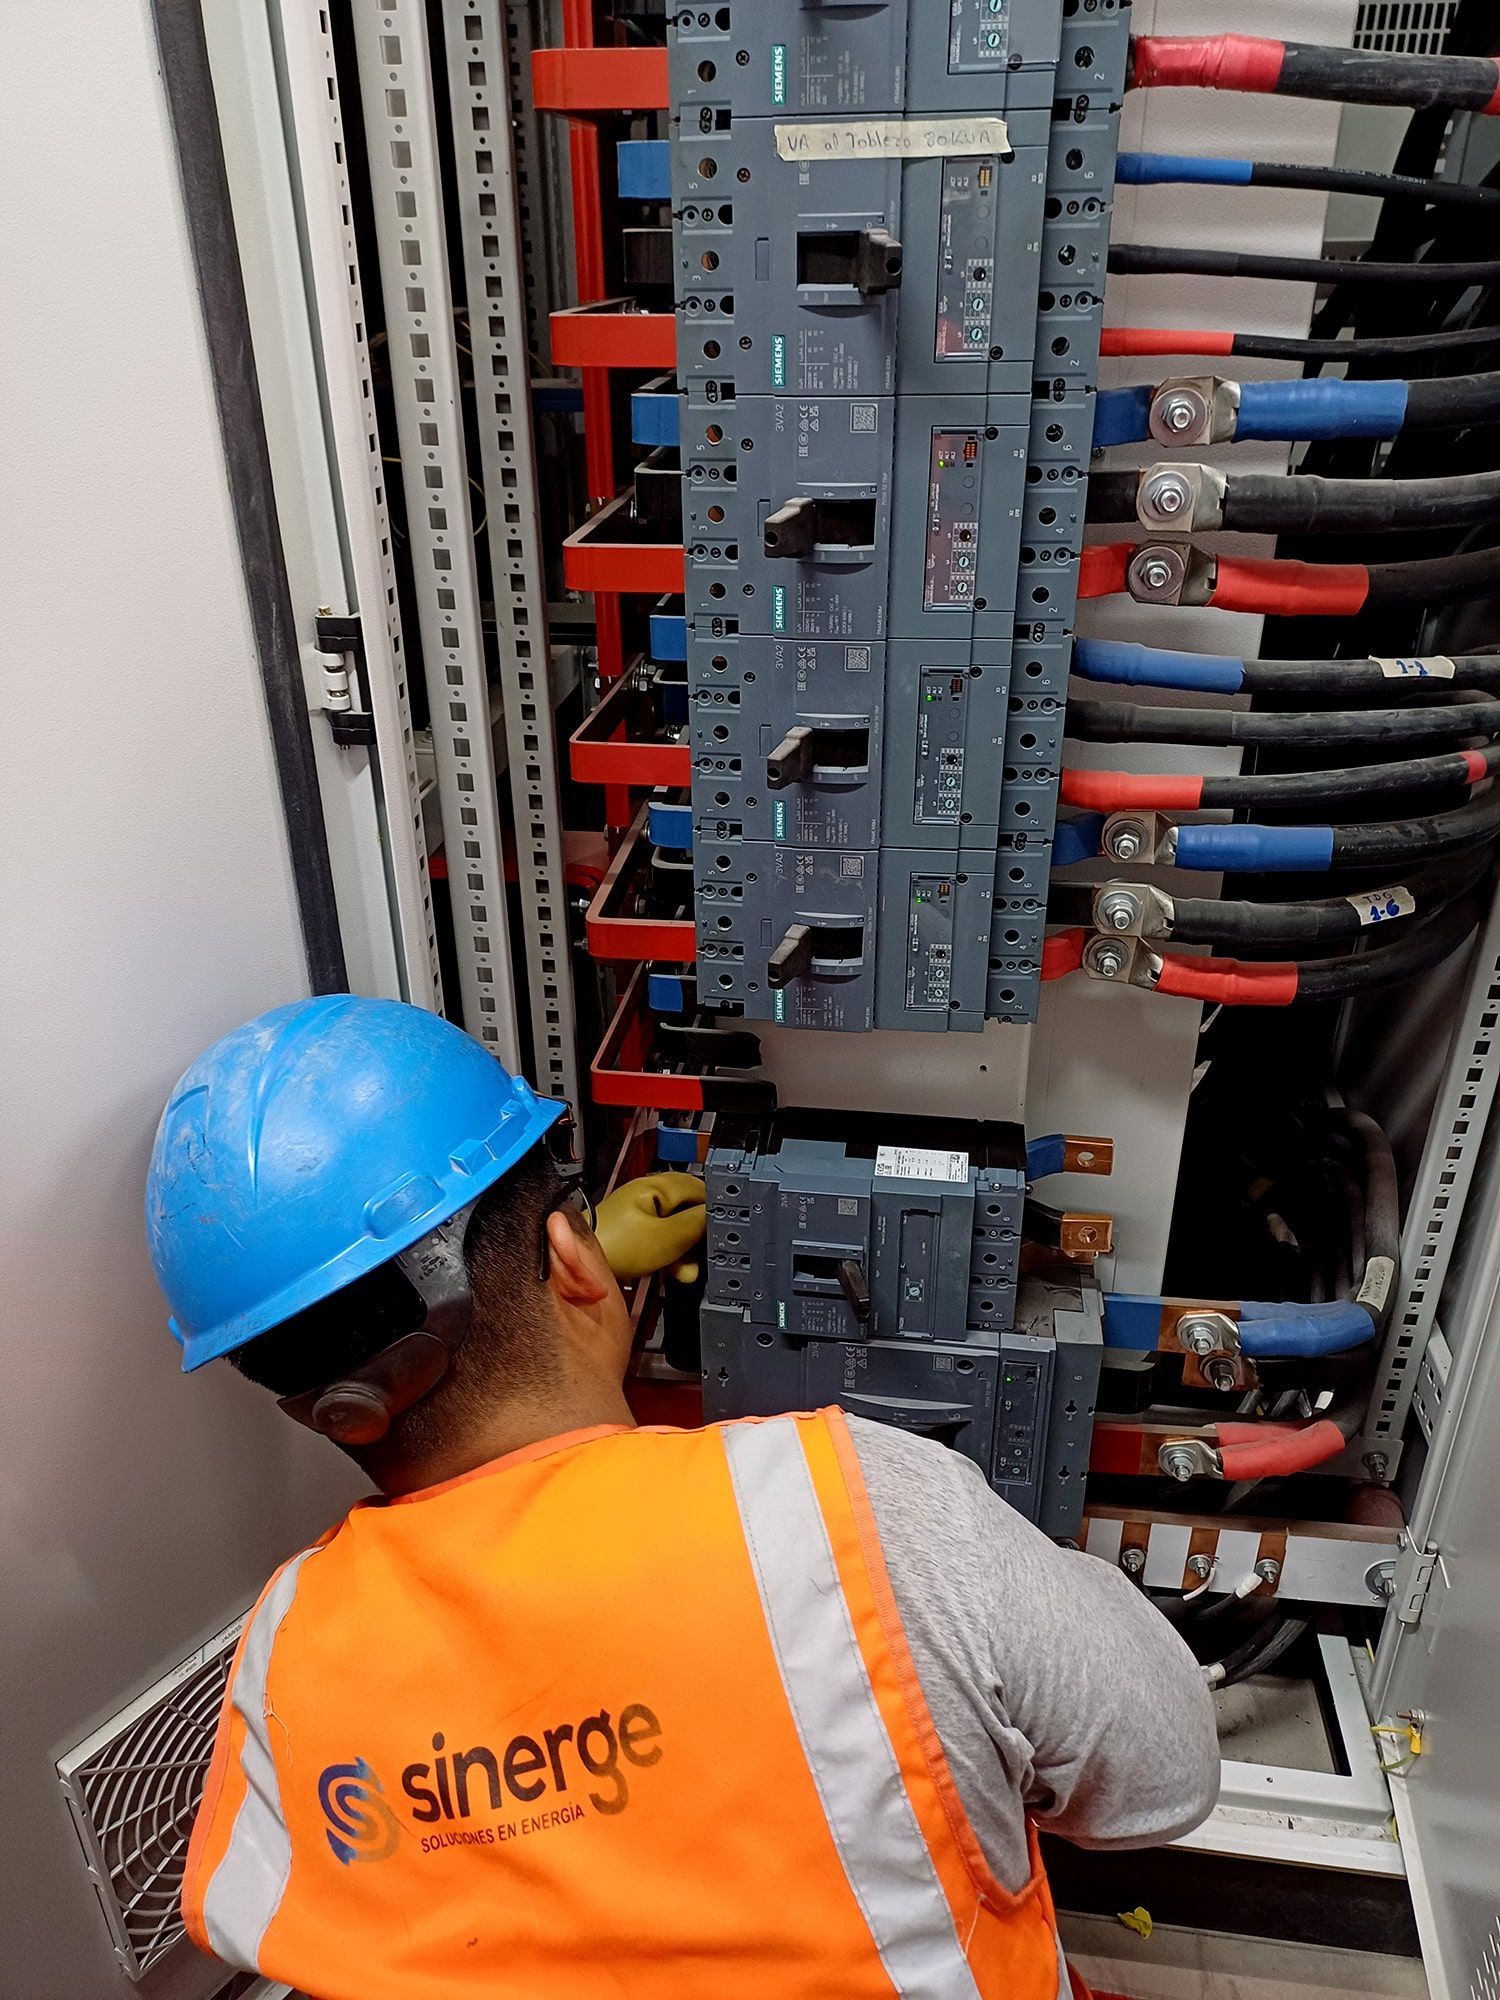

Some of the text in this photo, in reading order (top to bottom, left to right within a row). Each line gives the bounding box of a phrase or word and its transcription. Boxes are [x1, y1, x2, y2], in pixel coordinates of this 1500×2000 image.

[774, 47, 783, 102] SIEMENS
[787, 135, 810, 152] VA
[774, 337, 783, 386] SIEMENS
[775, 403, 784, 432] 3VA2
[775, 587, 783, 629] SIEMENS
[775, 644, 784, 669] 3VA2
[776, 851, 784, 874] 3VA2
[1370, 898, 1400, 921] 1-6
[401, 1703, 664, 1823] sinerge
[421, 1828, 495, 1854] SOLUCIONES
[498, 1823, 517, 1841] EN
